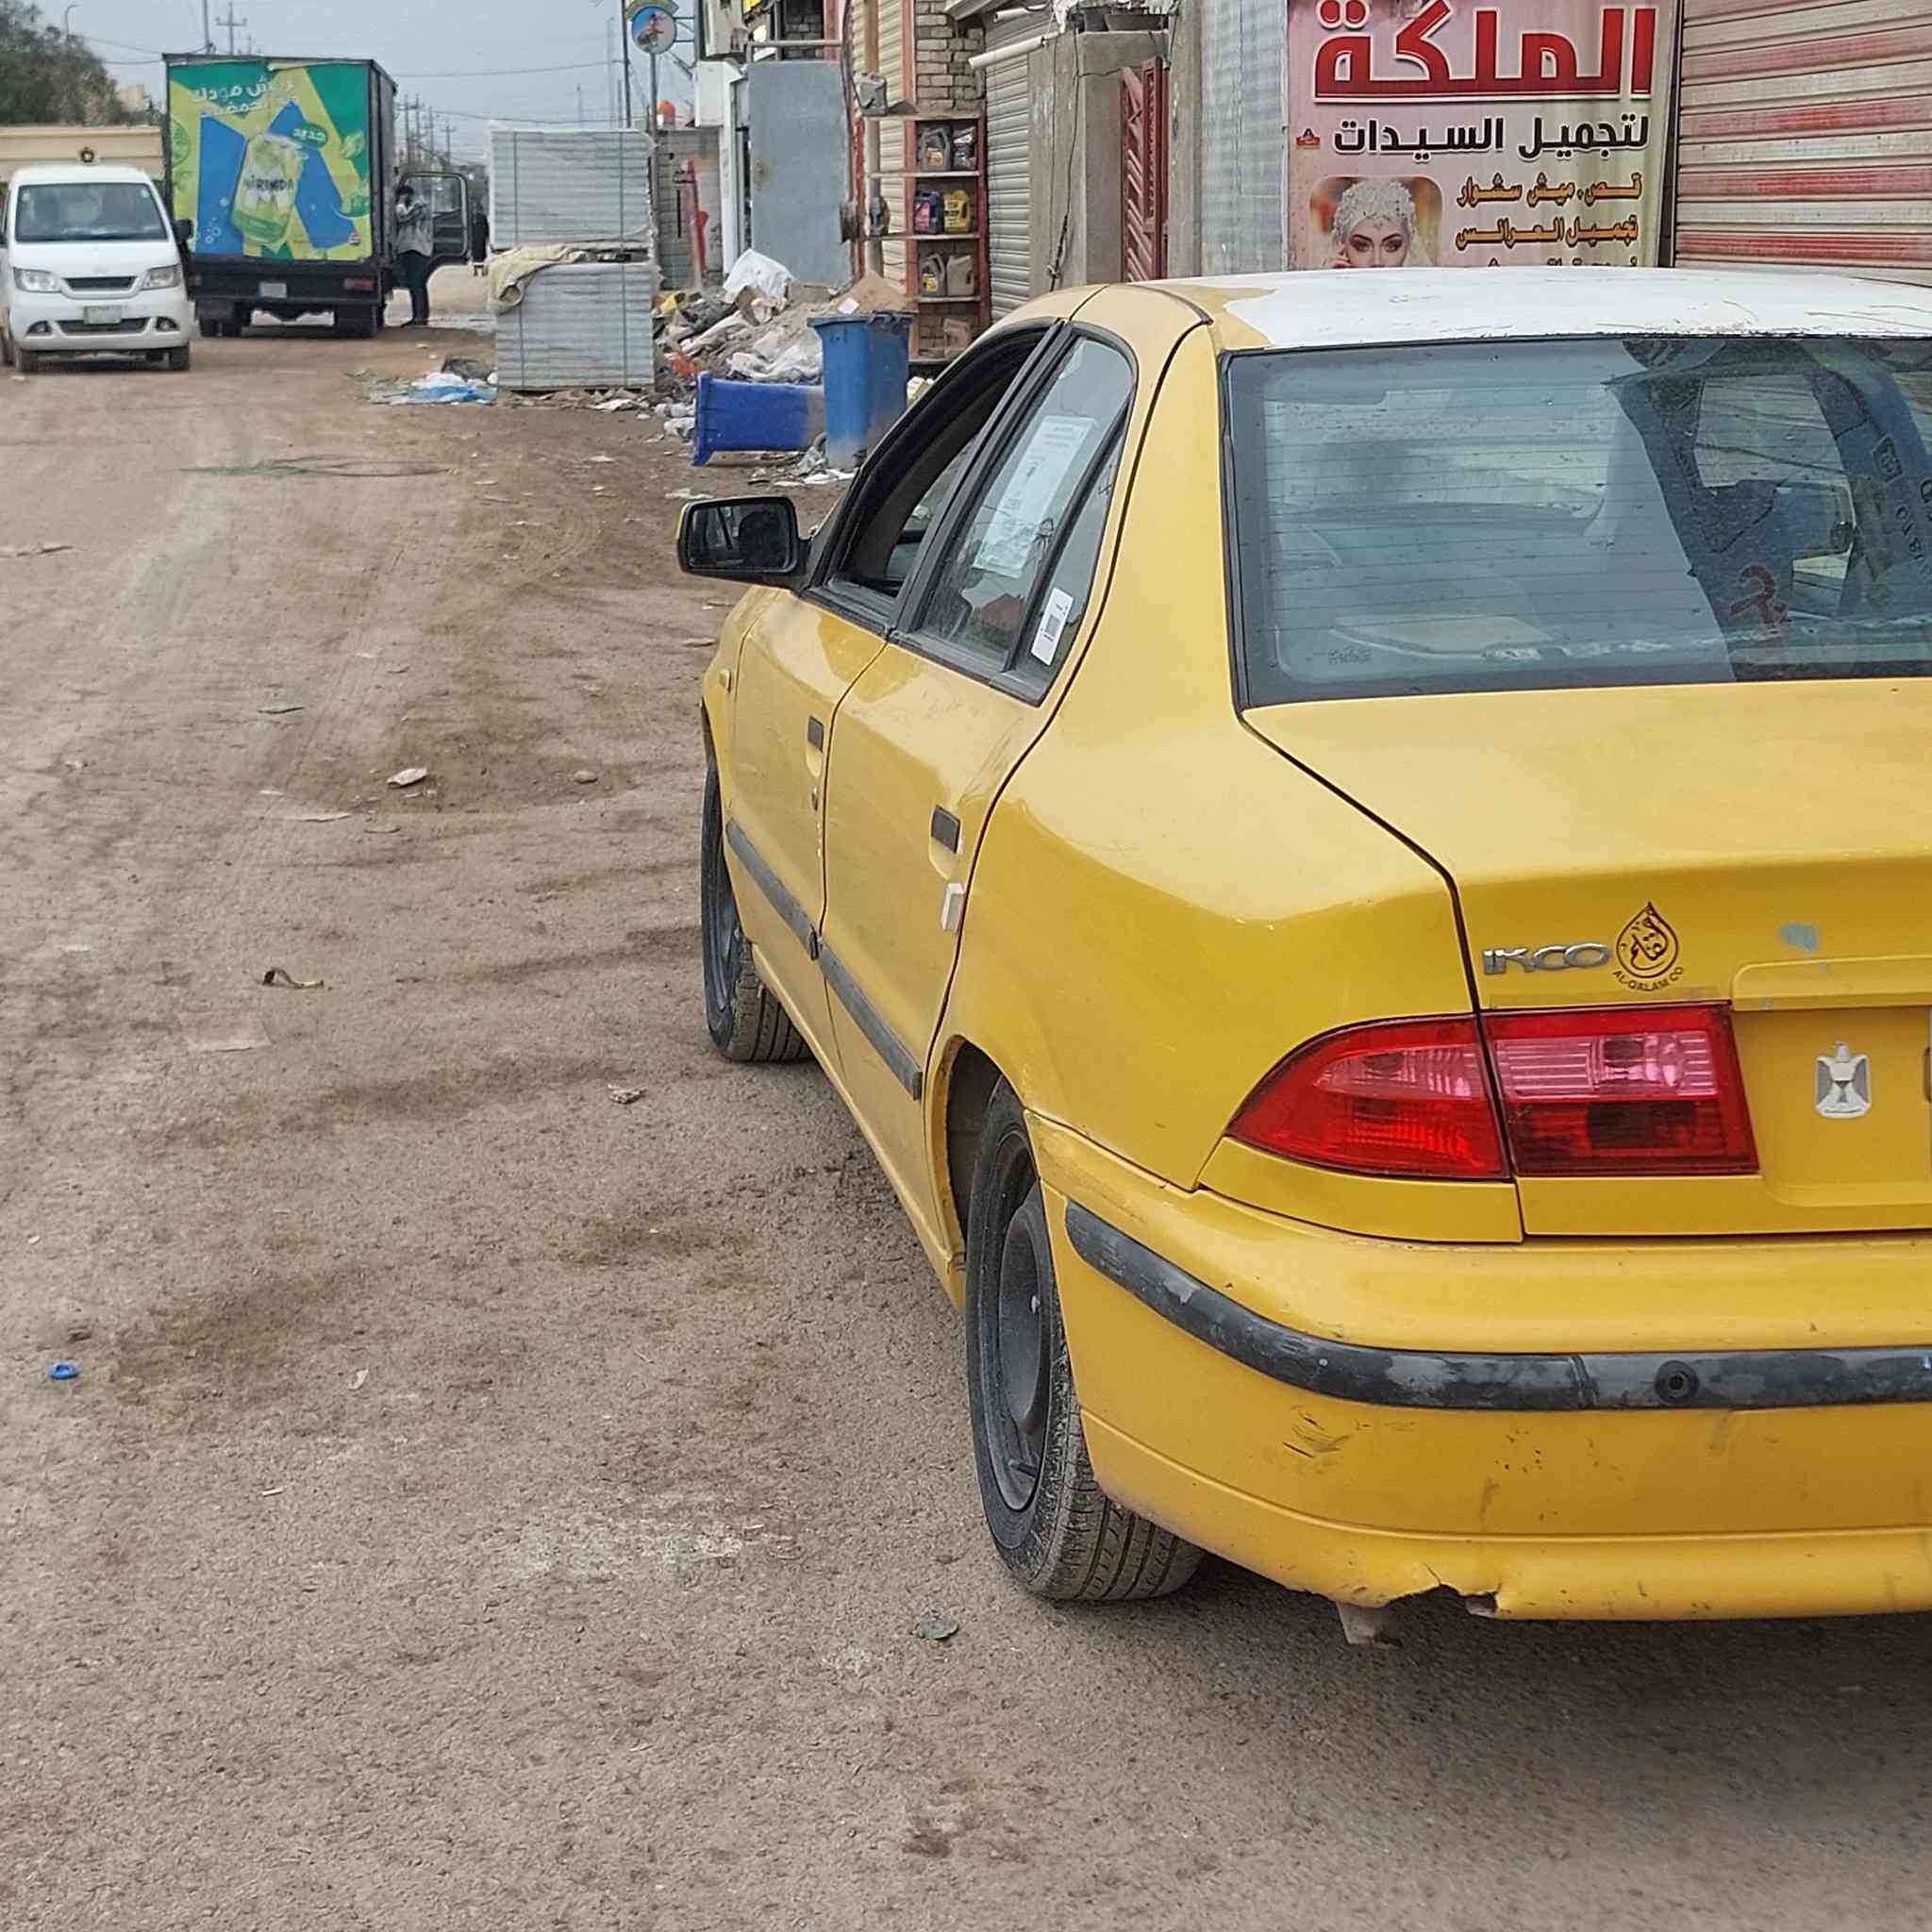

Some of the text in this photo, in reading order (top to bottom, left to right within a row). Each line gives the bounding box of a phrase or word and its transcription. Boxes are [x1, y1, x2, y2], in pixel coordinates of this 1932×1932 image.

[1314, 0, 1656, 98] الملكة
[1334, 113, 1649, 160] لتجميل السيدات
[1567, 215, 1640, 247] تجميل
[1484, 943, 1609, 974] IKCO
